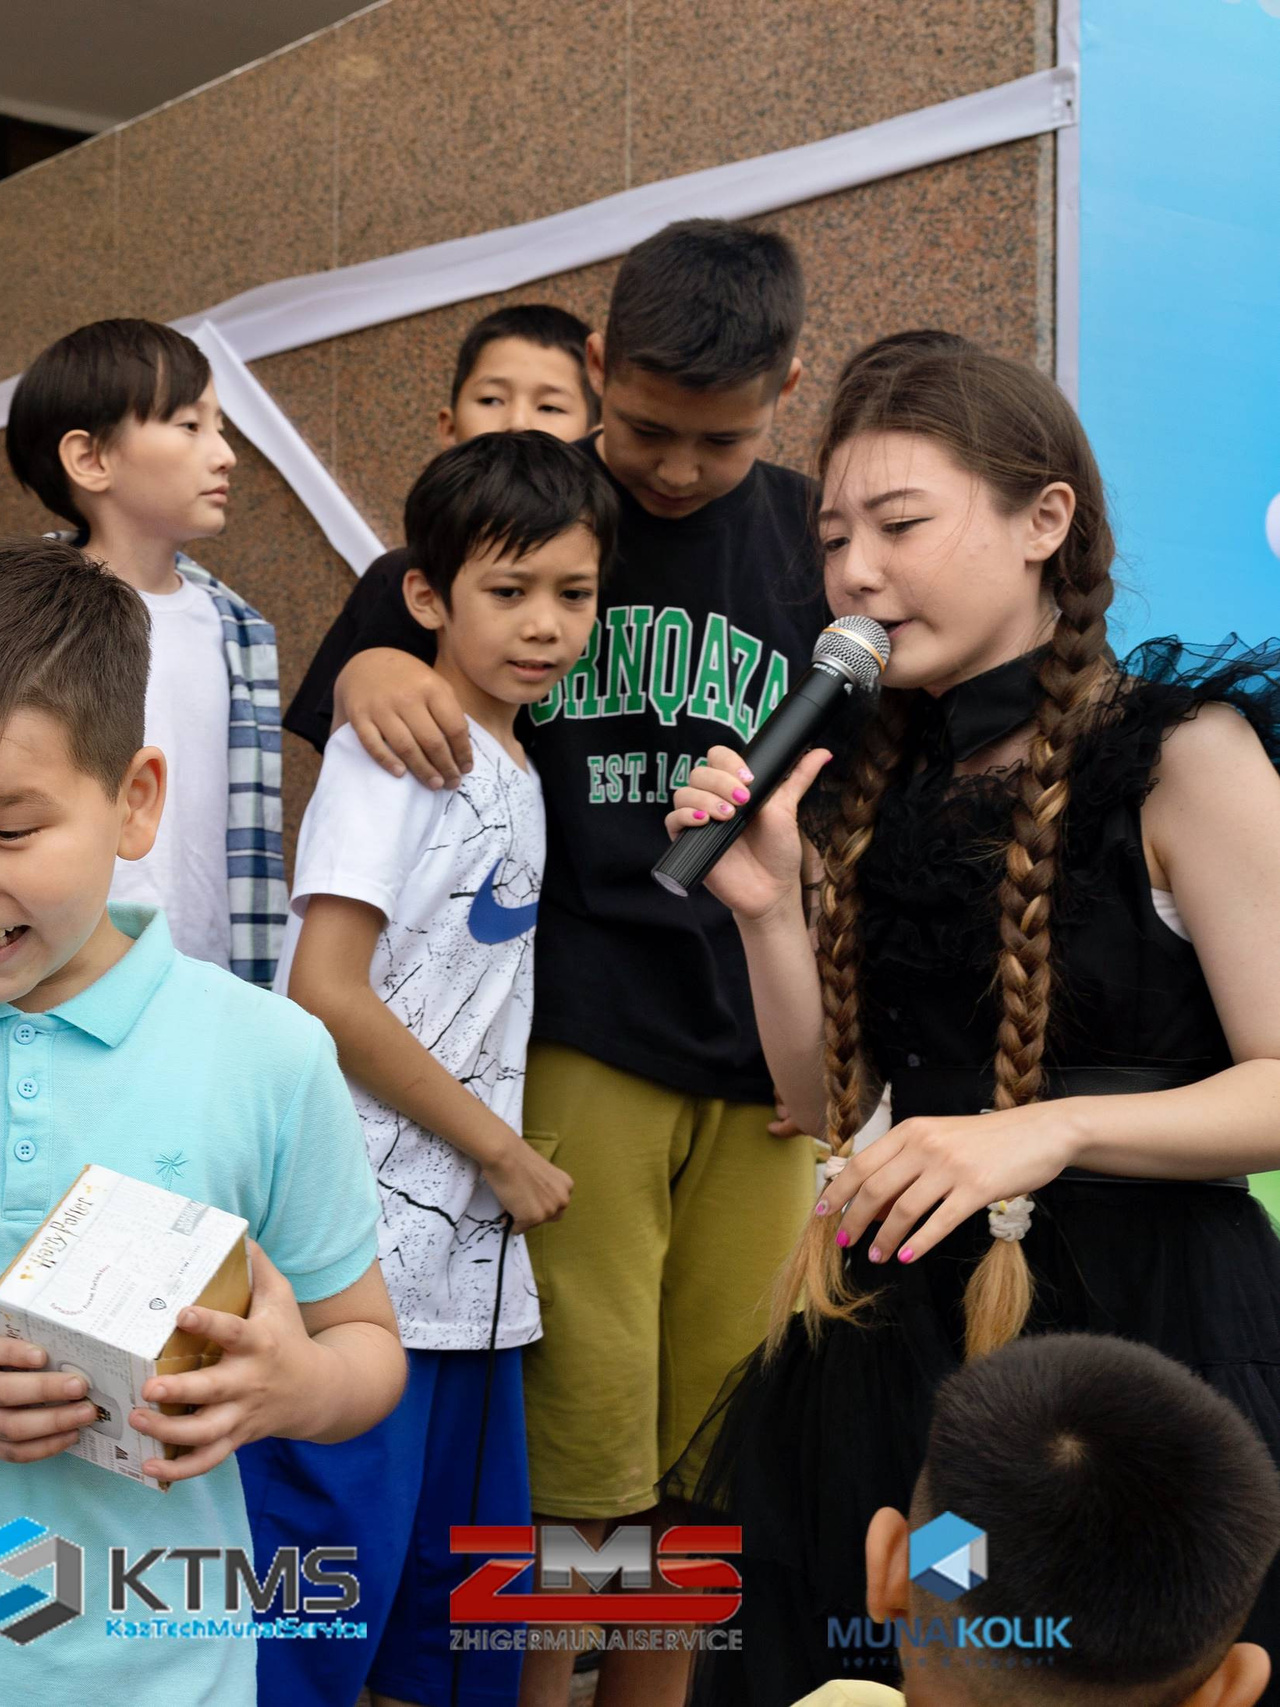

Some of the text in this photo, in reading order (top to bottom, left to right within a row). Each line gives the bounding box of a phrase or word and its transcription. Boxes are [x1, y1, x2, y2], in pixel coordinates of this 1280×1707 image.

[587, 752, 708, 803] EST.14
[28, 1232, 68, 1269] Harry
[50, 1196, 94, 1238] Potter
